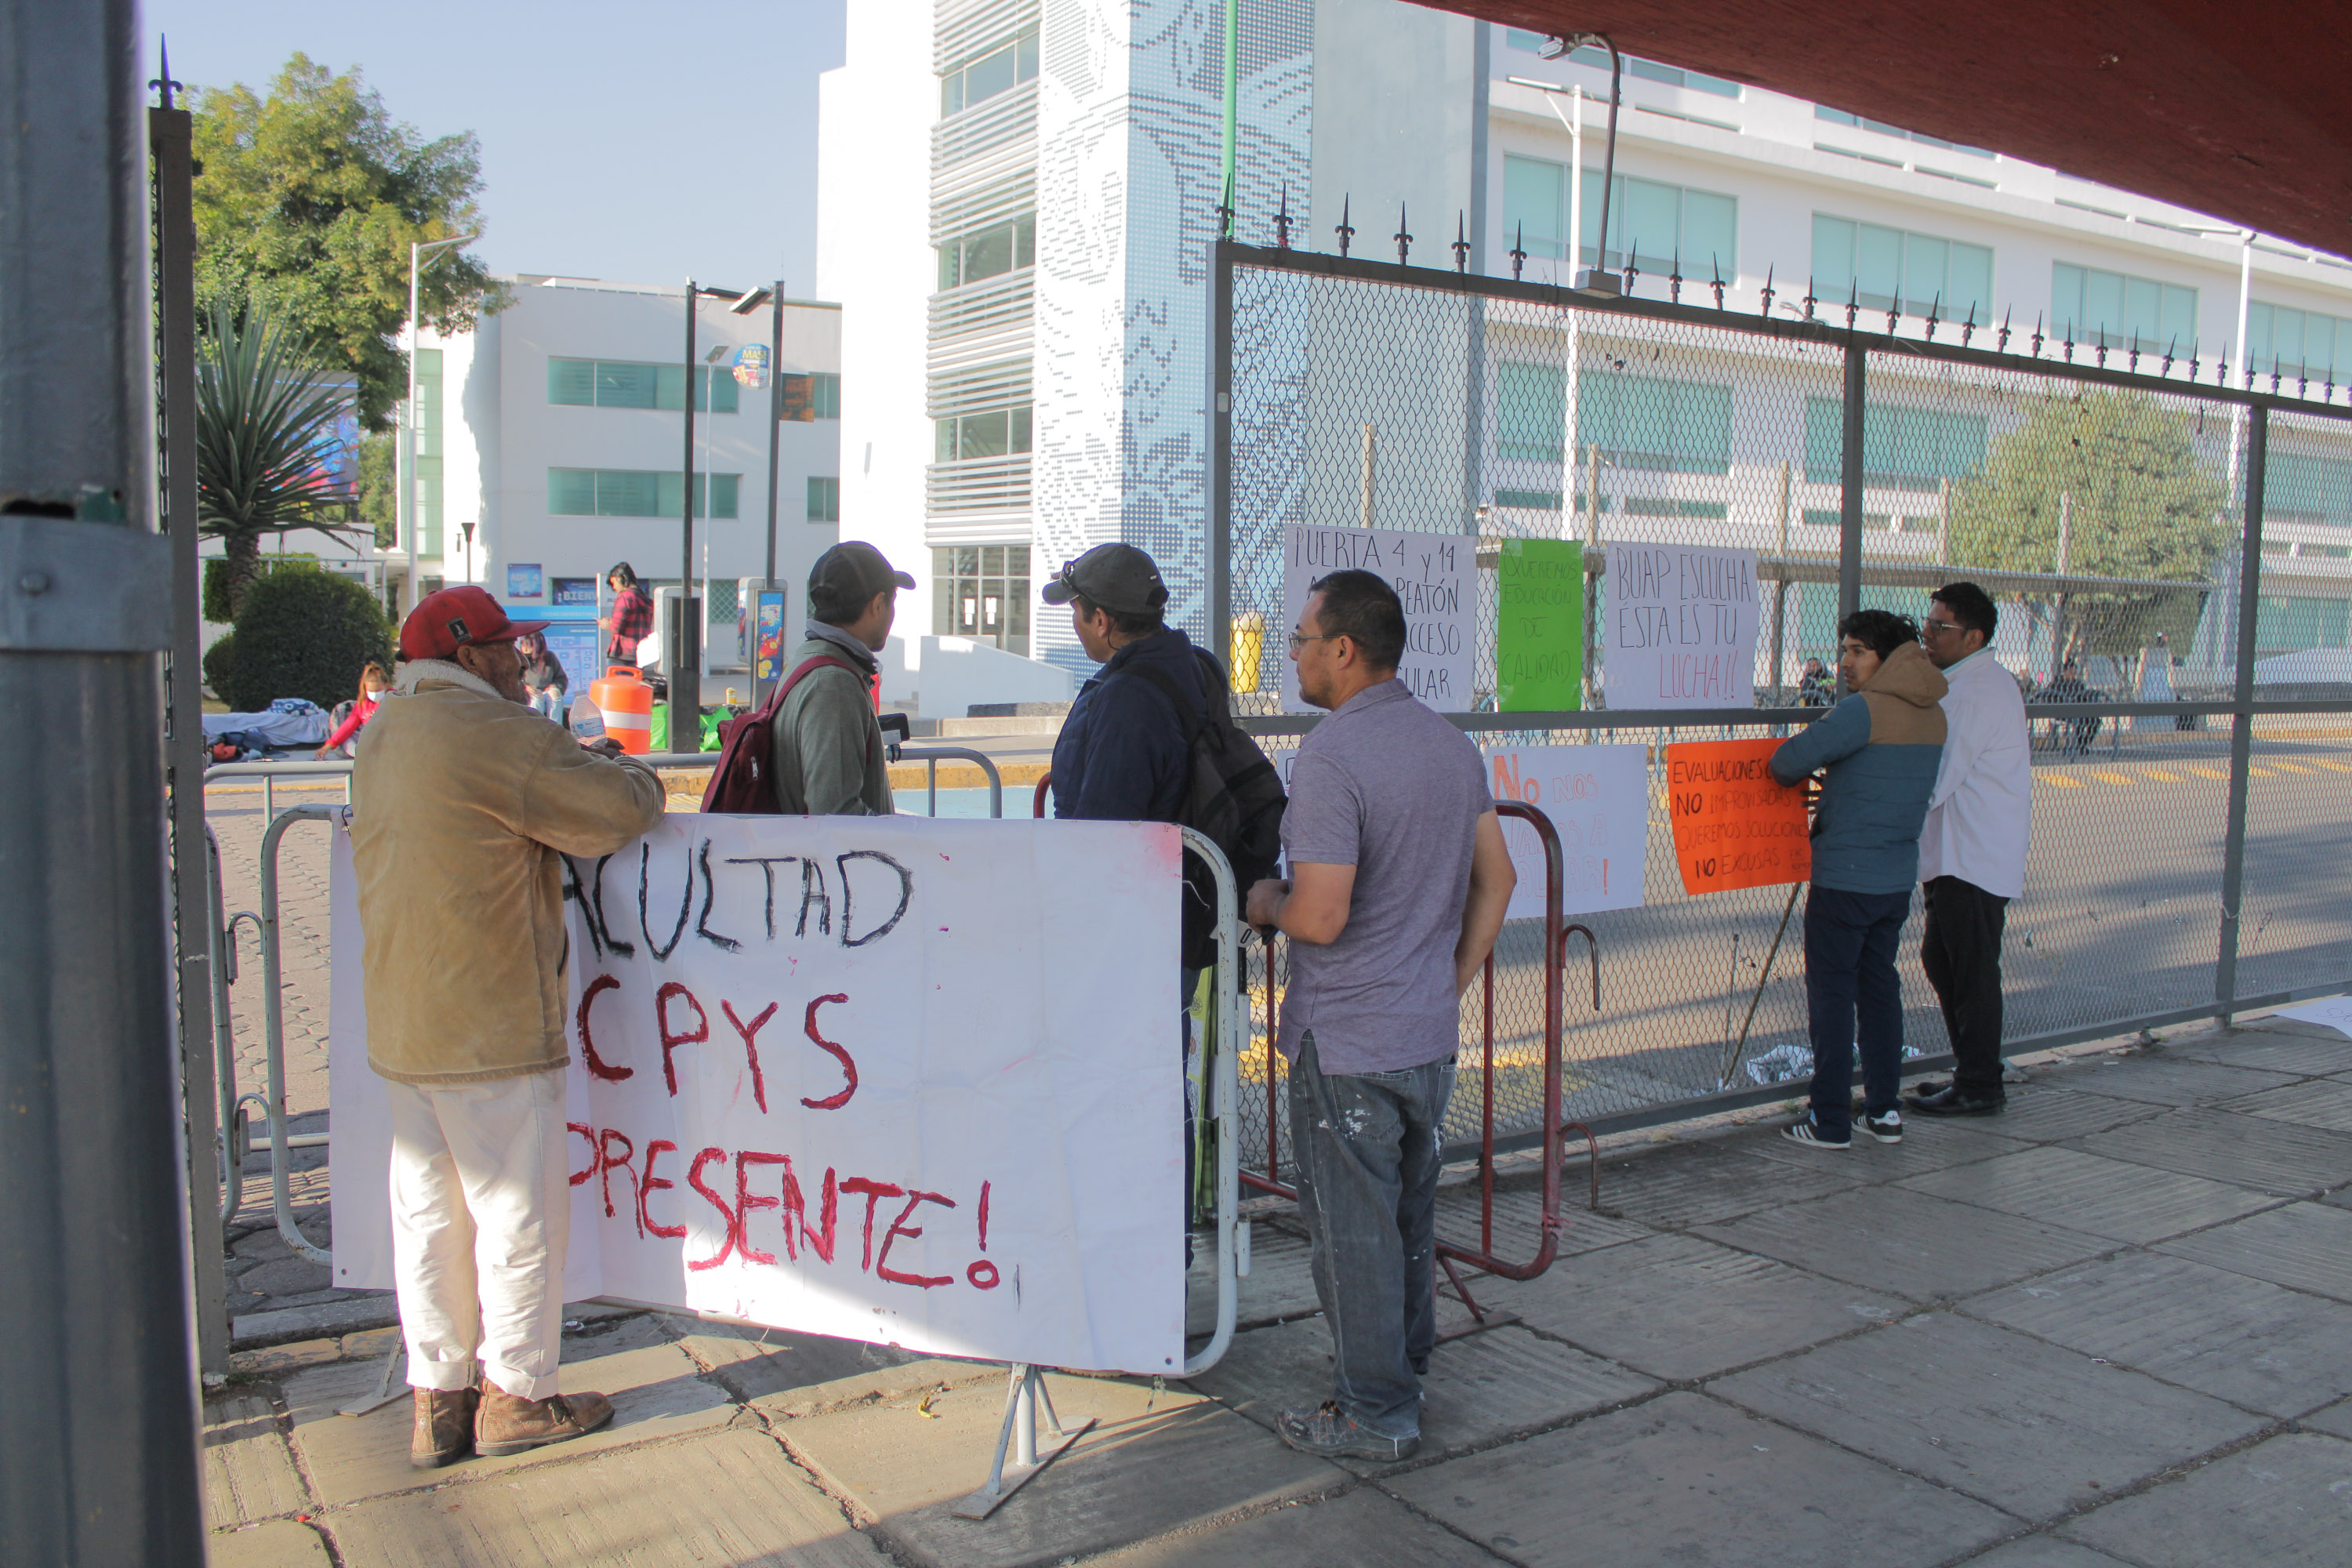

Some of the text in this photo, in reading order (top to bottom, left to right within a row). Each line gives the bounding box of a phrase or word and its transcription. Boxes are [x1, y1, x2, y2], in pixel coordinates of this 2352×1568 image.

[1295, 526, 1382, 568] PUERTA
[1392, 539, 1406, 567] 4
[1438, 541, 1455, 573] 14
[1503, 547, 1579, 581] QUEREMOS
[1616, 546, 1751, 603] BUAP ESCUCHA
[1396, 577, 1459, 615] PEATÓN
[1504, 583, 1573, 606] EDUCACIÓN
[1519, 616, 1550, 640] DE
[1619, 601, 1737, 648] ÉSTA ES TU
[1398, 666, 1454, 700] ULAR.
[1501, 649, 1571, 686] CALIDAD
[1660, 649, 1739, 701] LUCHA!!
[1552, 773, 1599, 803] NOS
[1673, 758, 1763, 784] EVALUACIONES
[1676, 789, 1792, 816] NO IMPROVISADAS
[1589, 813, 1607, 847] A
[1678, 821, 1810, 852] QUEREMOS SOLUCIONES
[1512, 855, 1610, 898] ALAR!
[1696, 858, 1717, 879] NO
[1721, 847, 1780, 875] EXCUSAS
[577, 973, 859, 1116] CPYS
